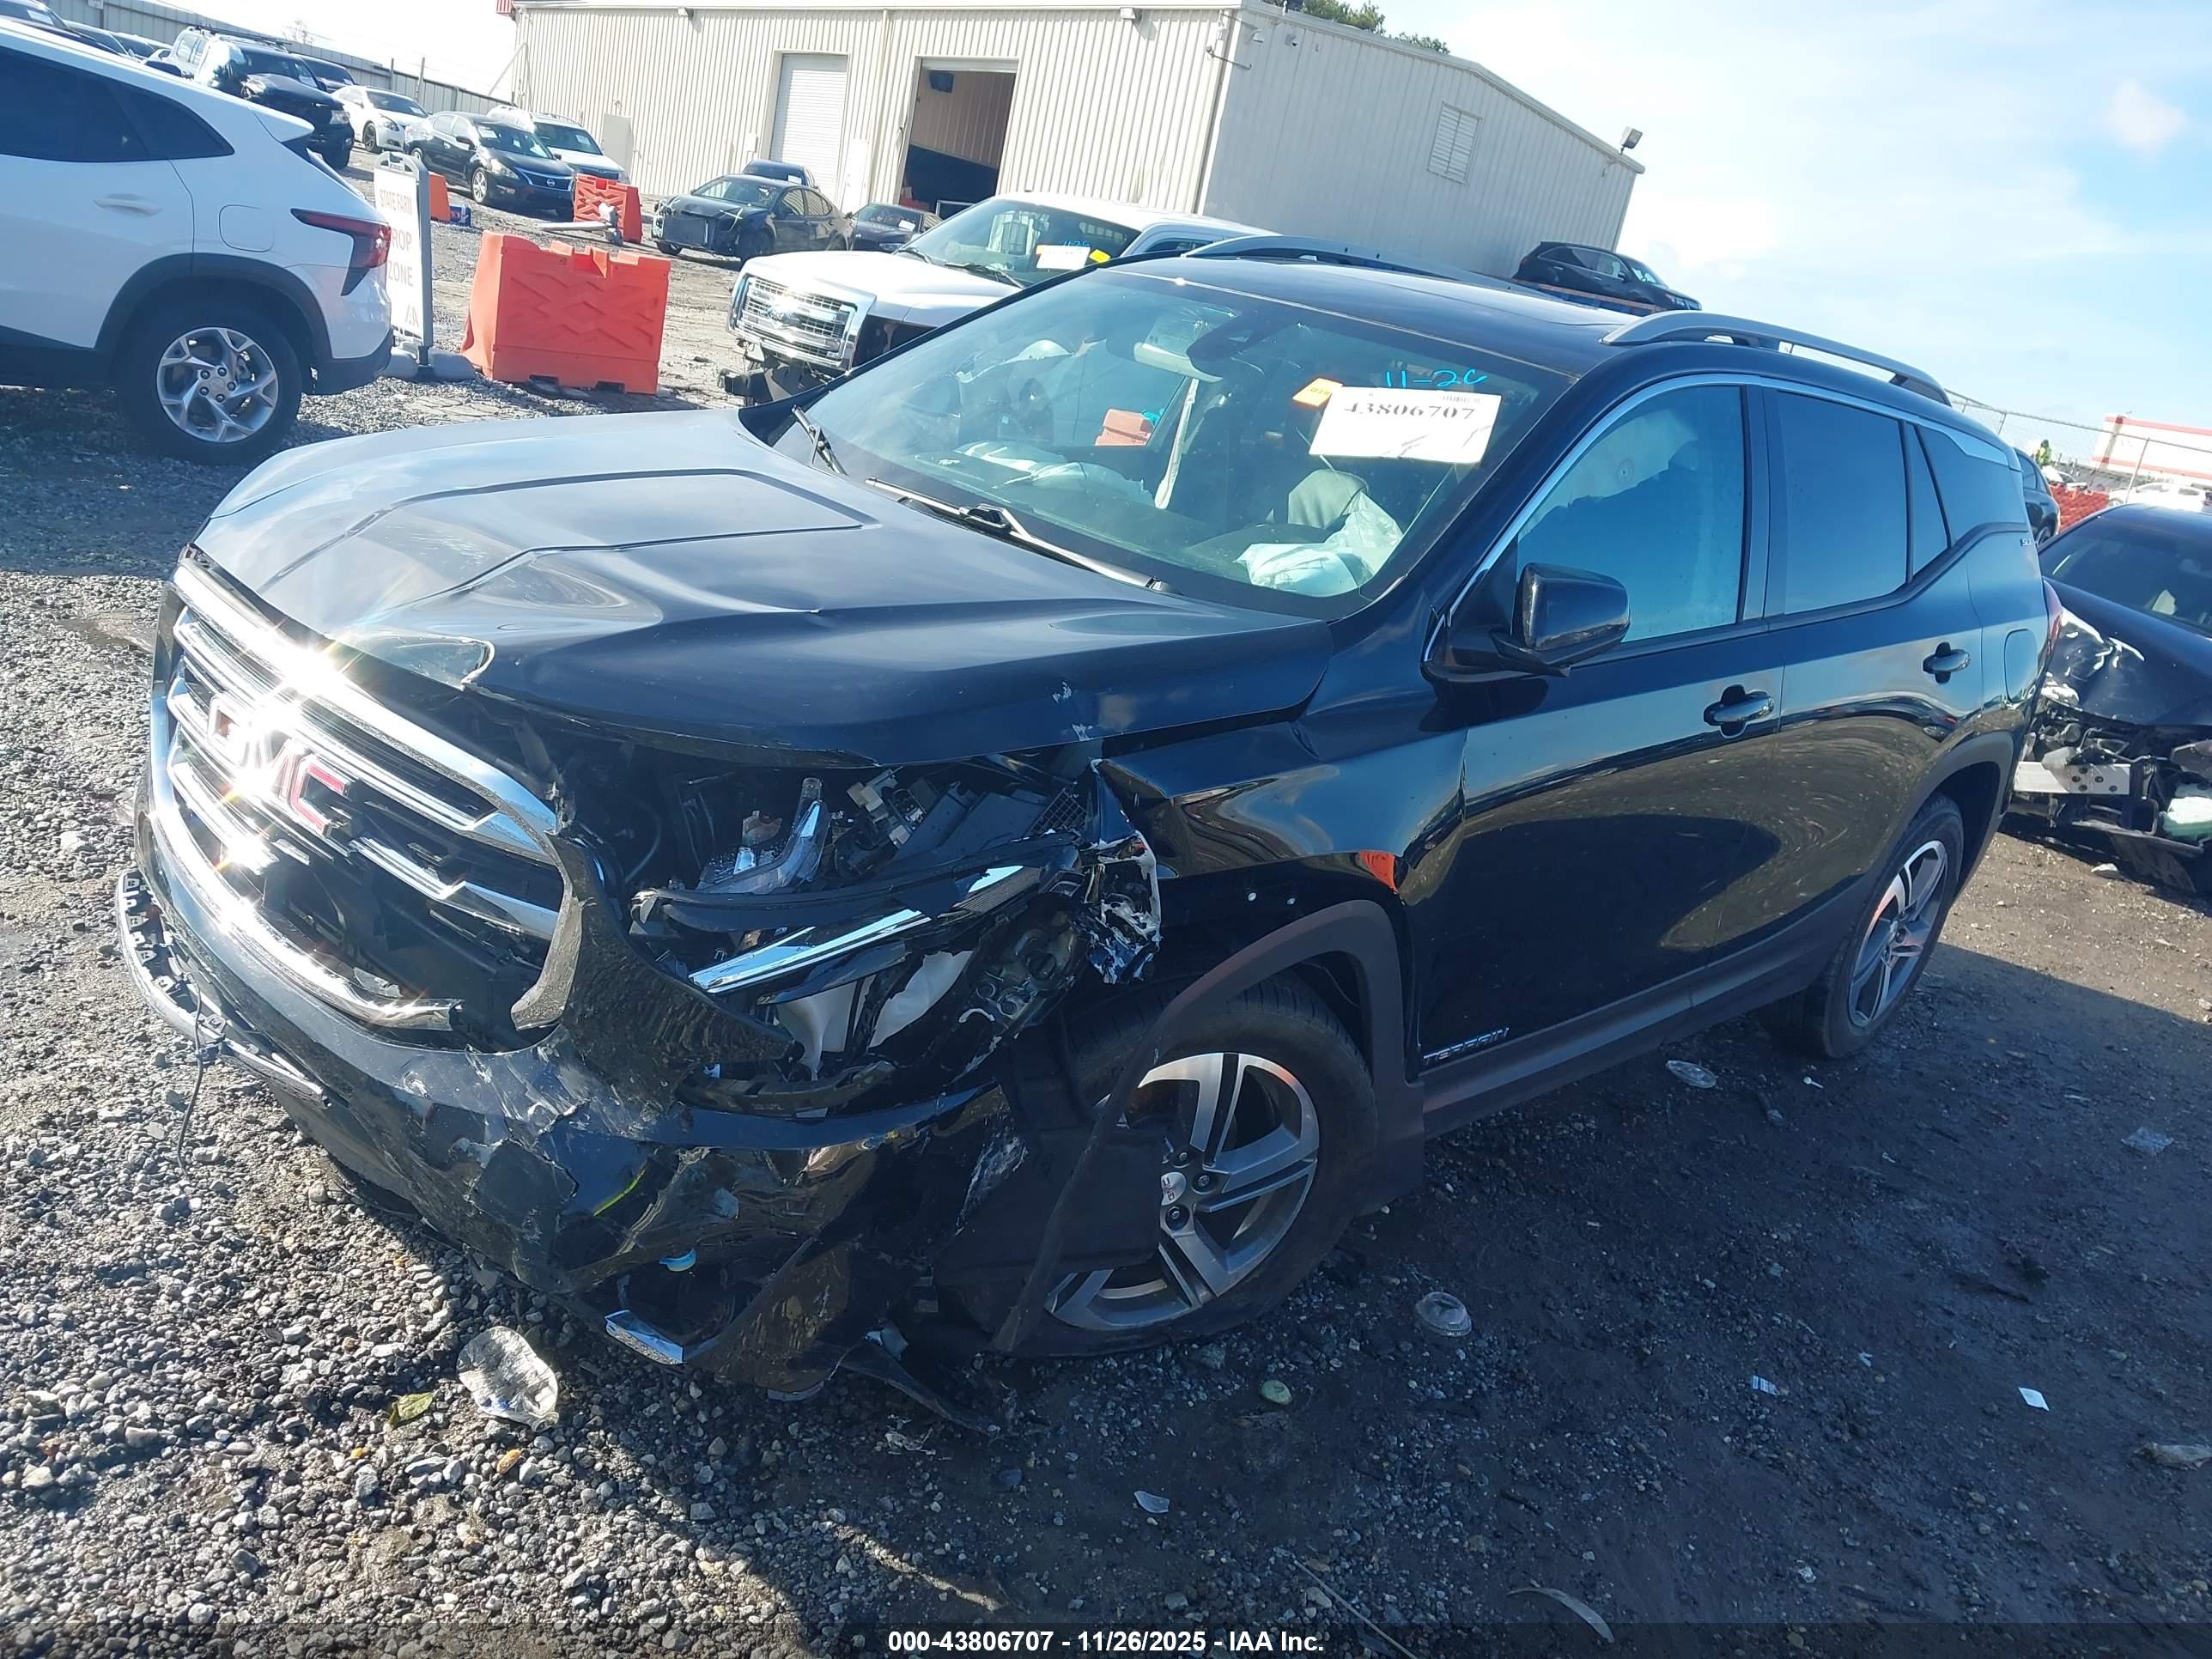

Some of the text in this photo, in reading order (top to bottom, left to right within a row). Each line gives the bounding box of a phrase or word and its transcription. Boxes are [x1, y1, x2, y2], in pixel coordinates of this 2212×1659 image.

[380, 189, 413, 216] STATE FARM
[392, 227, 412, 252] ROP
[387, 260, 414, 288] ZONE
[1343, 402, 1475, 420] 43806707
